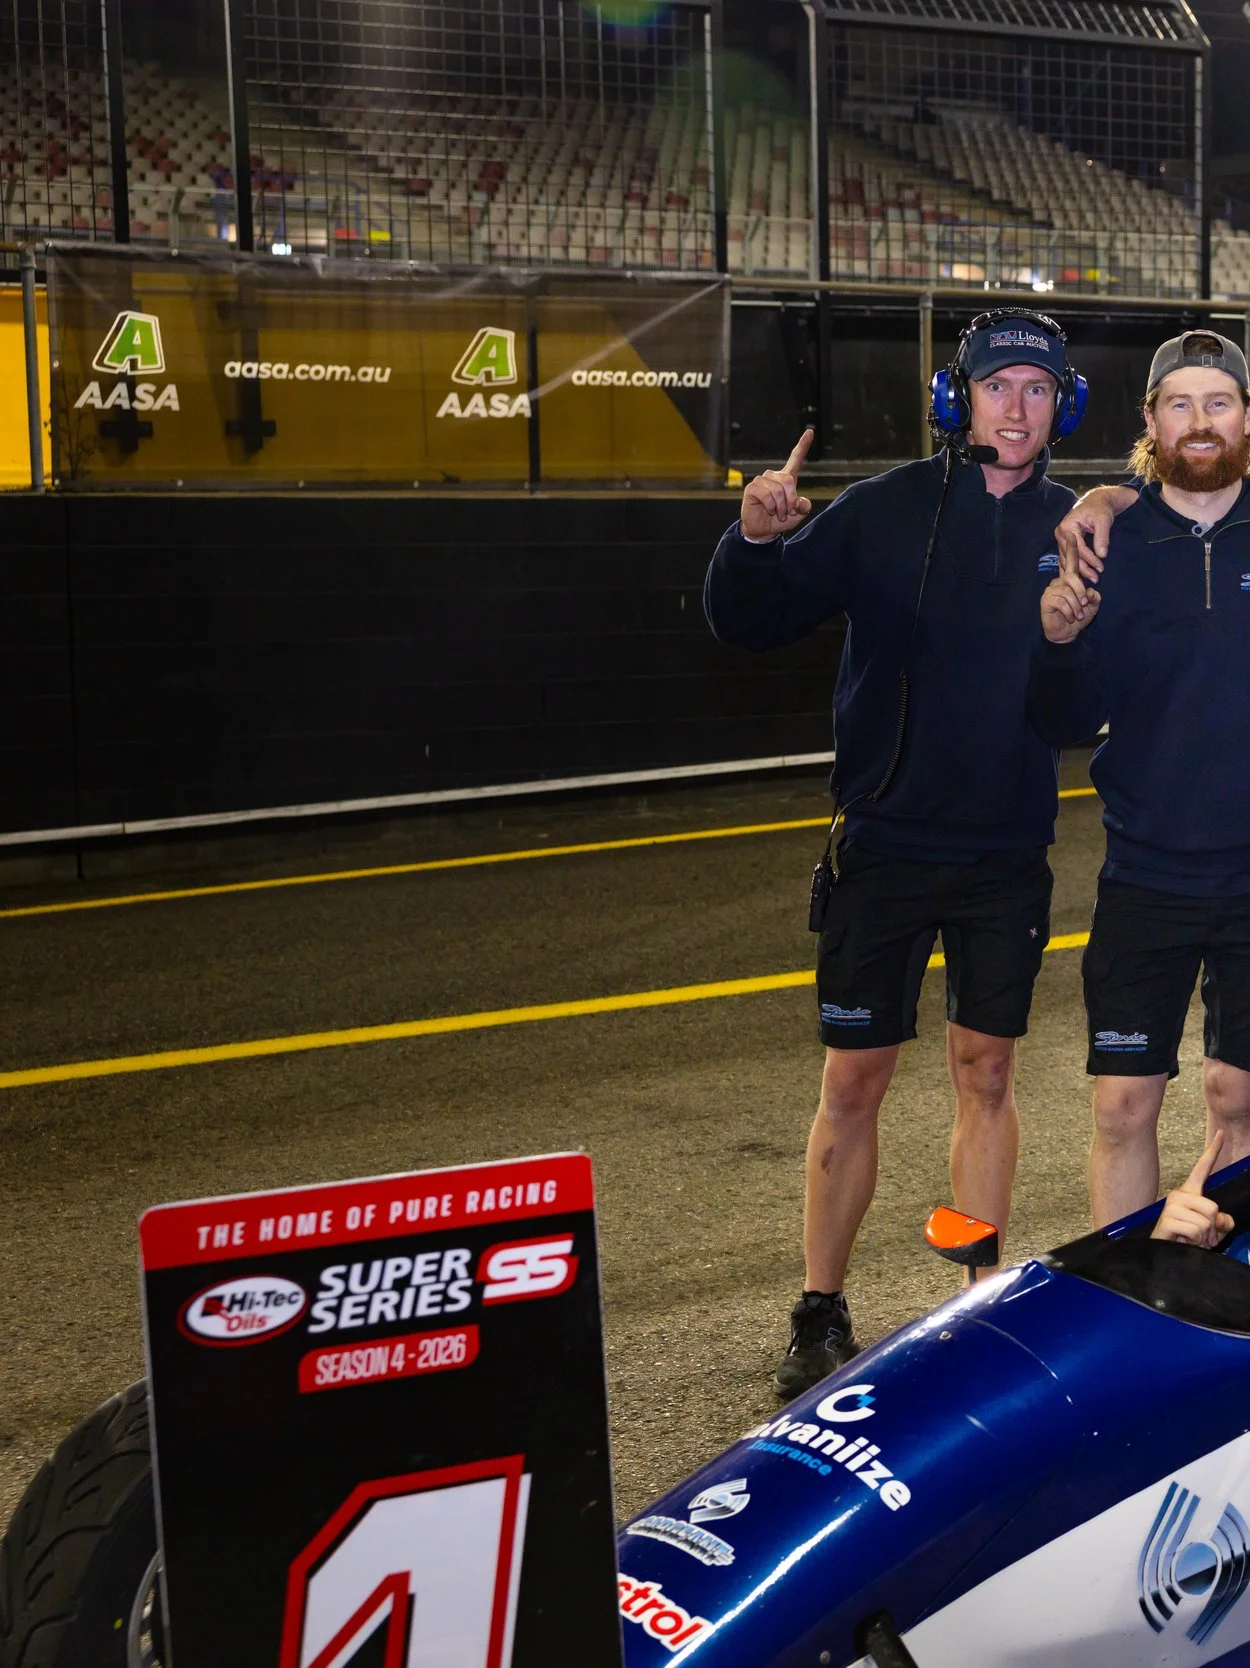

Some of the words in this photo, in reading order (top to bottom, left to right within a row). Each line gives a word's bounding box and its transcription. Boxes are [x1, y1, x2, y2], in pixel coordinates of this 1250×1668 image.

[1018, 331, 1049, 345] Lloyds
[224, 360, 392, 384] aasa.com.au
[571, 369, 712, 388] aasa.com.au
[74, 381, 181, 411] AASA
[436, 392, 532, 418] AASA
[197, 1221, 246, 1250] THE
[259, 1210, 333, 1242] HOME
[346, 1204, 377, 1230] OF
[389, 1194, 453, 1224] PURE
[465, 1180, 557, 1213] RACING
[317, 1248, 472, 1300] SUPER
[228, 1289, 301, 1313] Hi-Tec
[307, 1278, 473, 1333] SERIES
[226, 1312, 268, 1332] Oils
[315, 1345, 390, 1386] SEASON
[391, 1343, 405, 1372] 4
[417, 1333, 467, 1369] 2026
[742, 1413, 911, 1511] alvaniize
[745, 1439, 833, 1476] Insurance
[617, 1580, 704, 1647] strol
